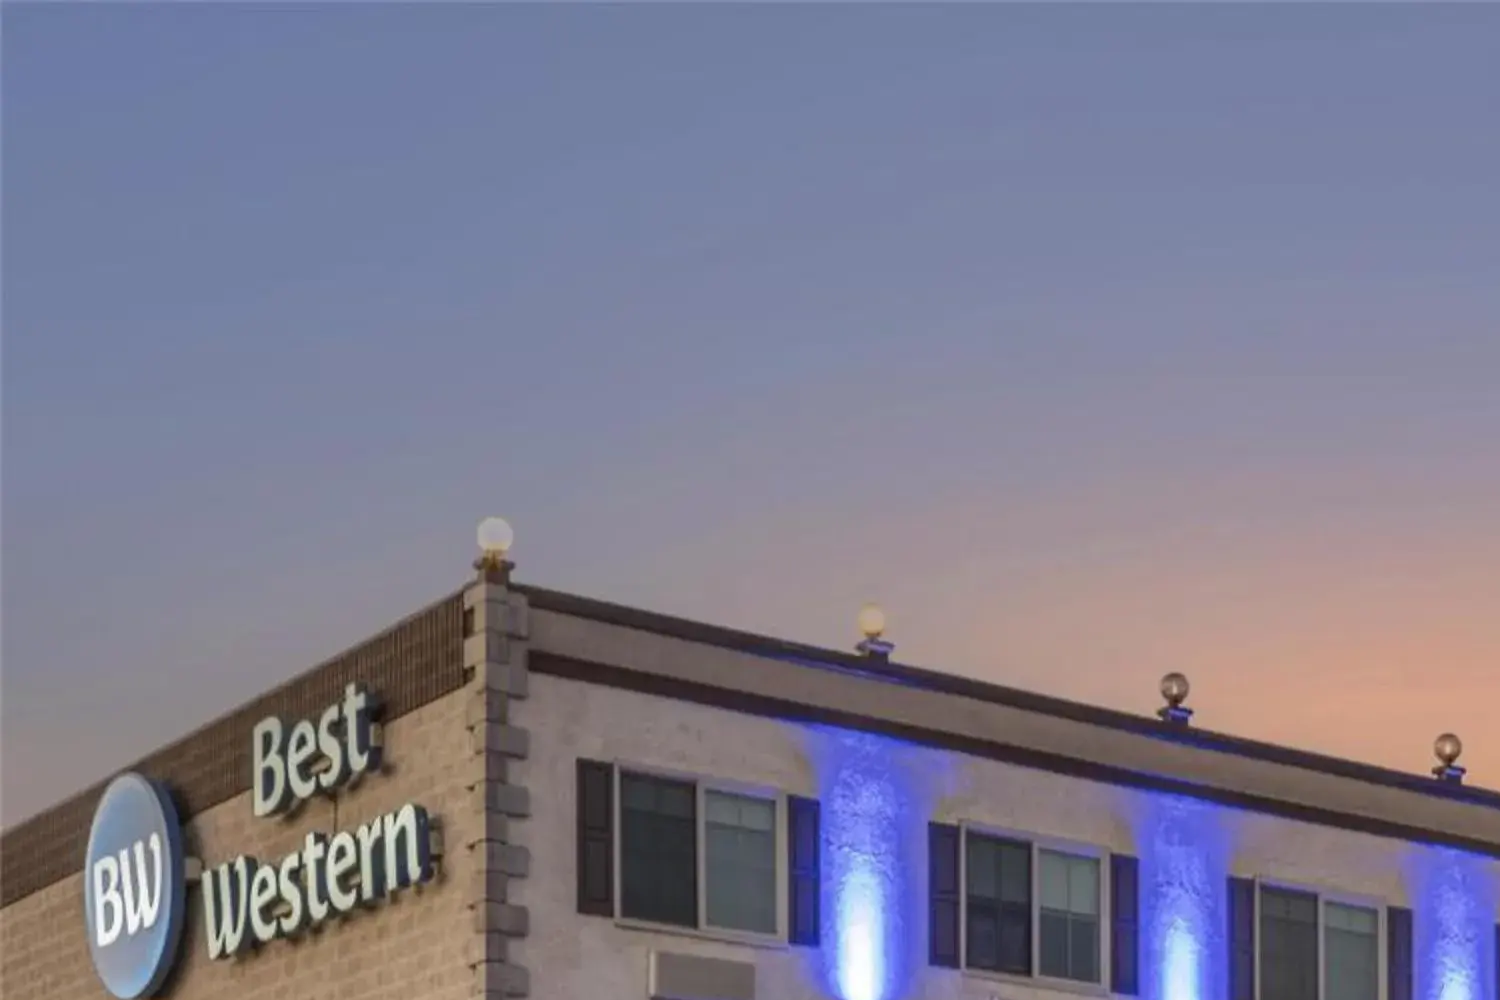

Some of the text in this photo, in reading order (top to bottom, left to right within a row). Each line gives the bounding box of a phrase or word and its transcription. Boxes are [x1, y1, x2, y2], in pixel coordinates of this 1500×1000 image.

[252, 681, 371, 818] Best
[93, 832, 164, 947] BW
[202, 803, 424, 961] Western
